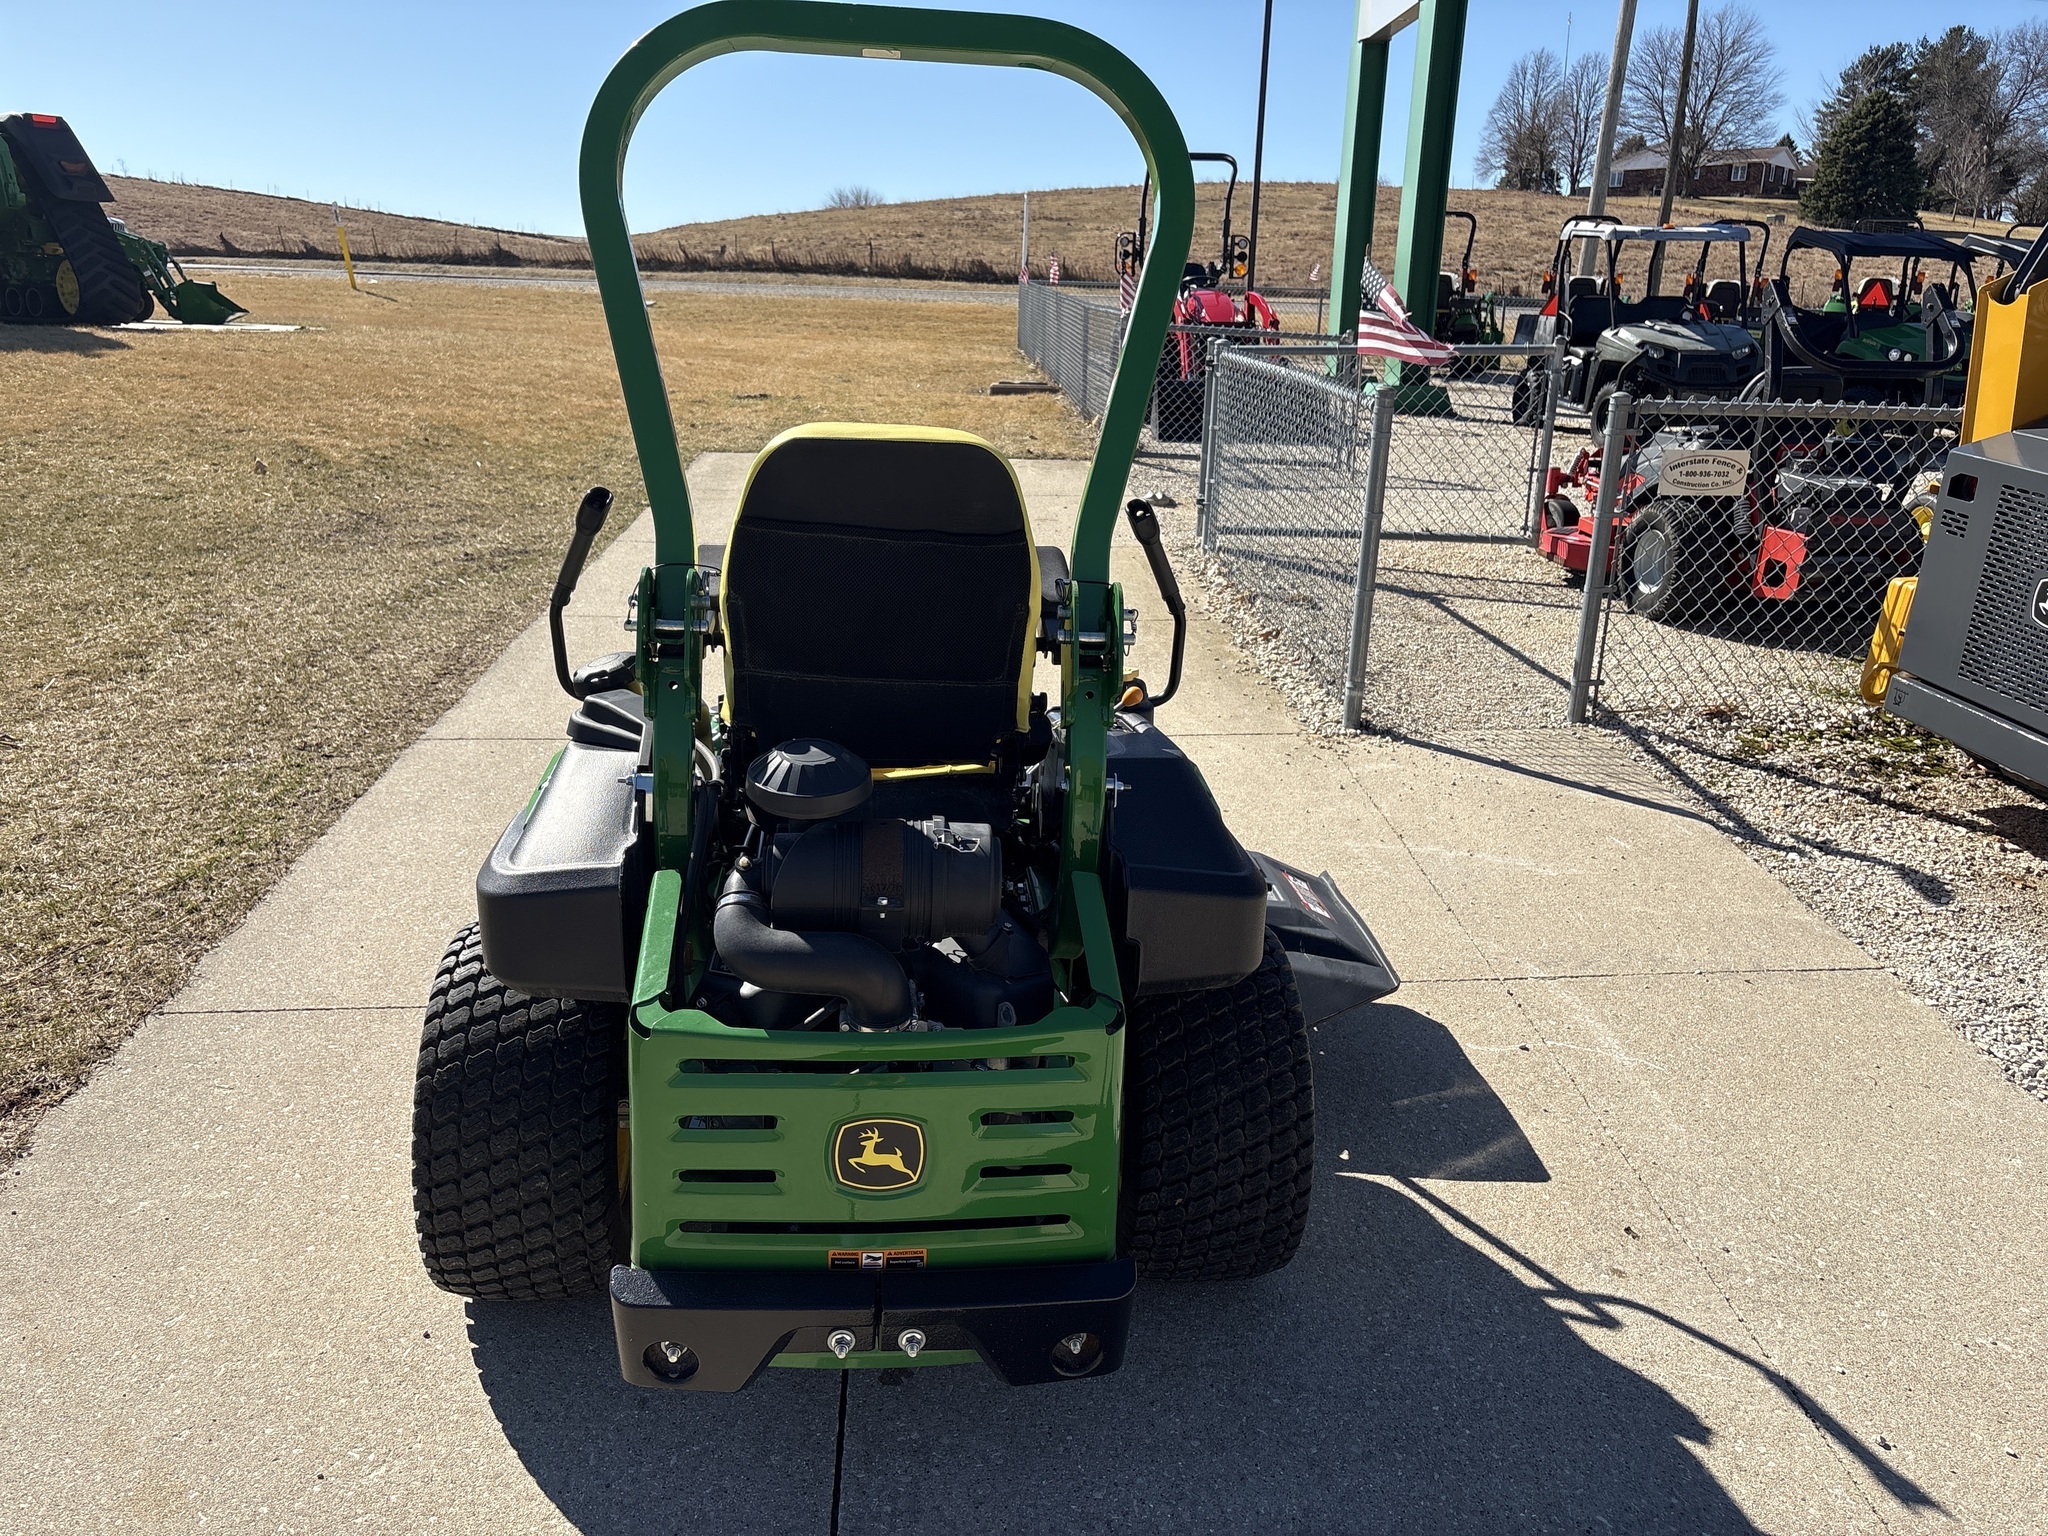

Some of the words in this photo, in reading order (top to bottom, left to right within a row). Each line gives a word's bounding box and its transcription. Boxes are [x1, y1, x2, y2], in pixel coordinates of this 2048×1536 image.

[1669, 458, 1710, 472] Interstate
[1712, 458, 1736, 469] Fence
[1736, 467, 1743, 475] &
[1672, 478, 1710, 488] Construction
